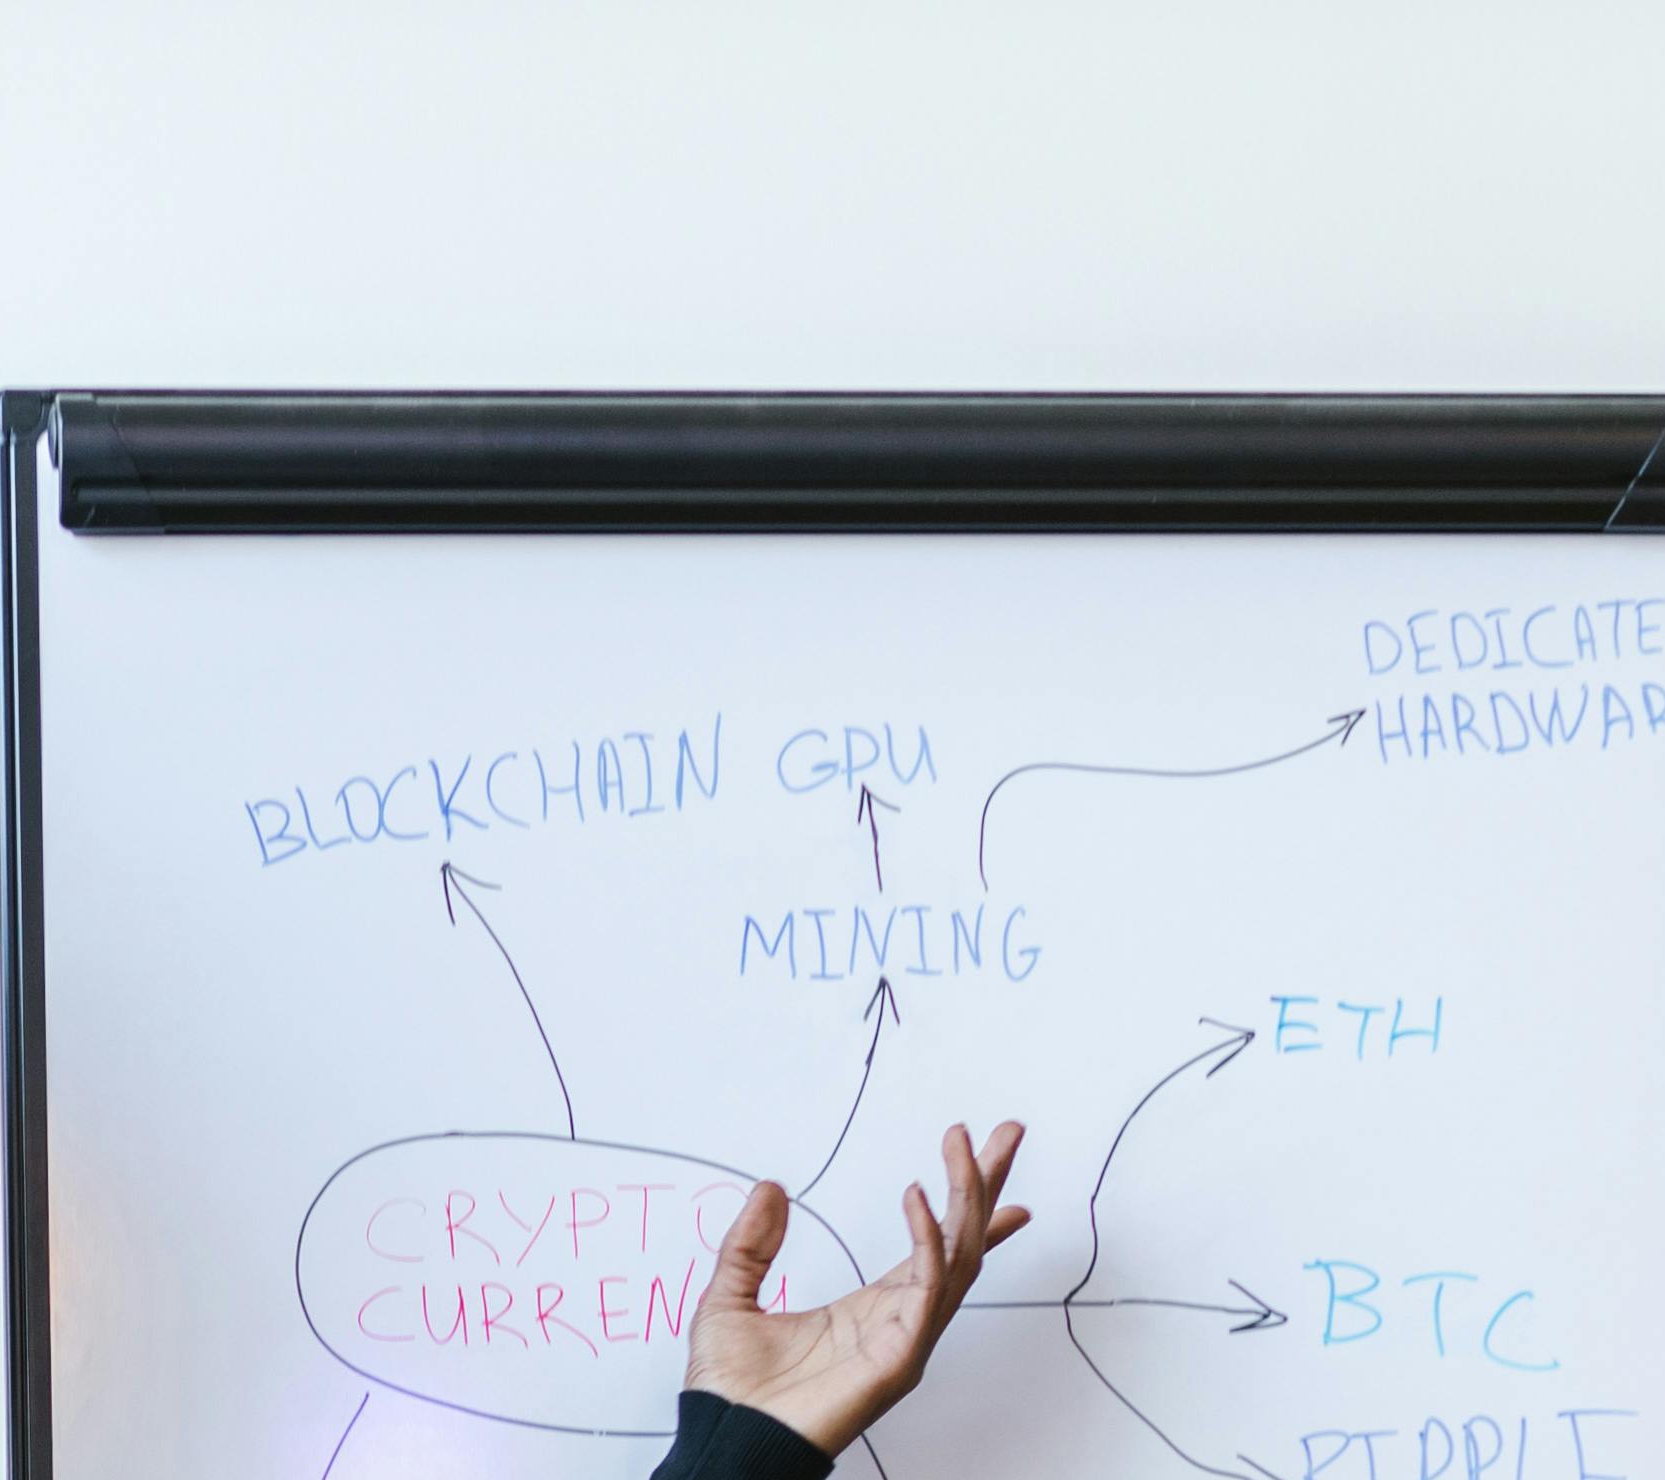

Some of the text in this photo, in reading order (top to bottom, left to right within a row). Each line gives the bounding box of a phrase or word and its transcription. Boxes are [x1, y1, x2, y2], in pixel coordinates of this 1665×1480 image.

[245, 711, 721, 867] BLOCKCHAIN
[777, 723, 937, 793] GPU
[741, 904, 1042, 982] MINING
[1270, 995, 1442, 1060] ETH
[1302, 1259, 1560, 1370] BTC
